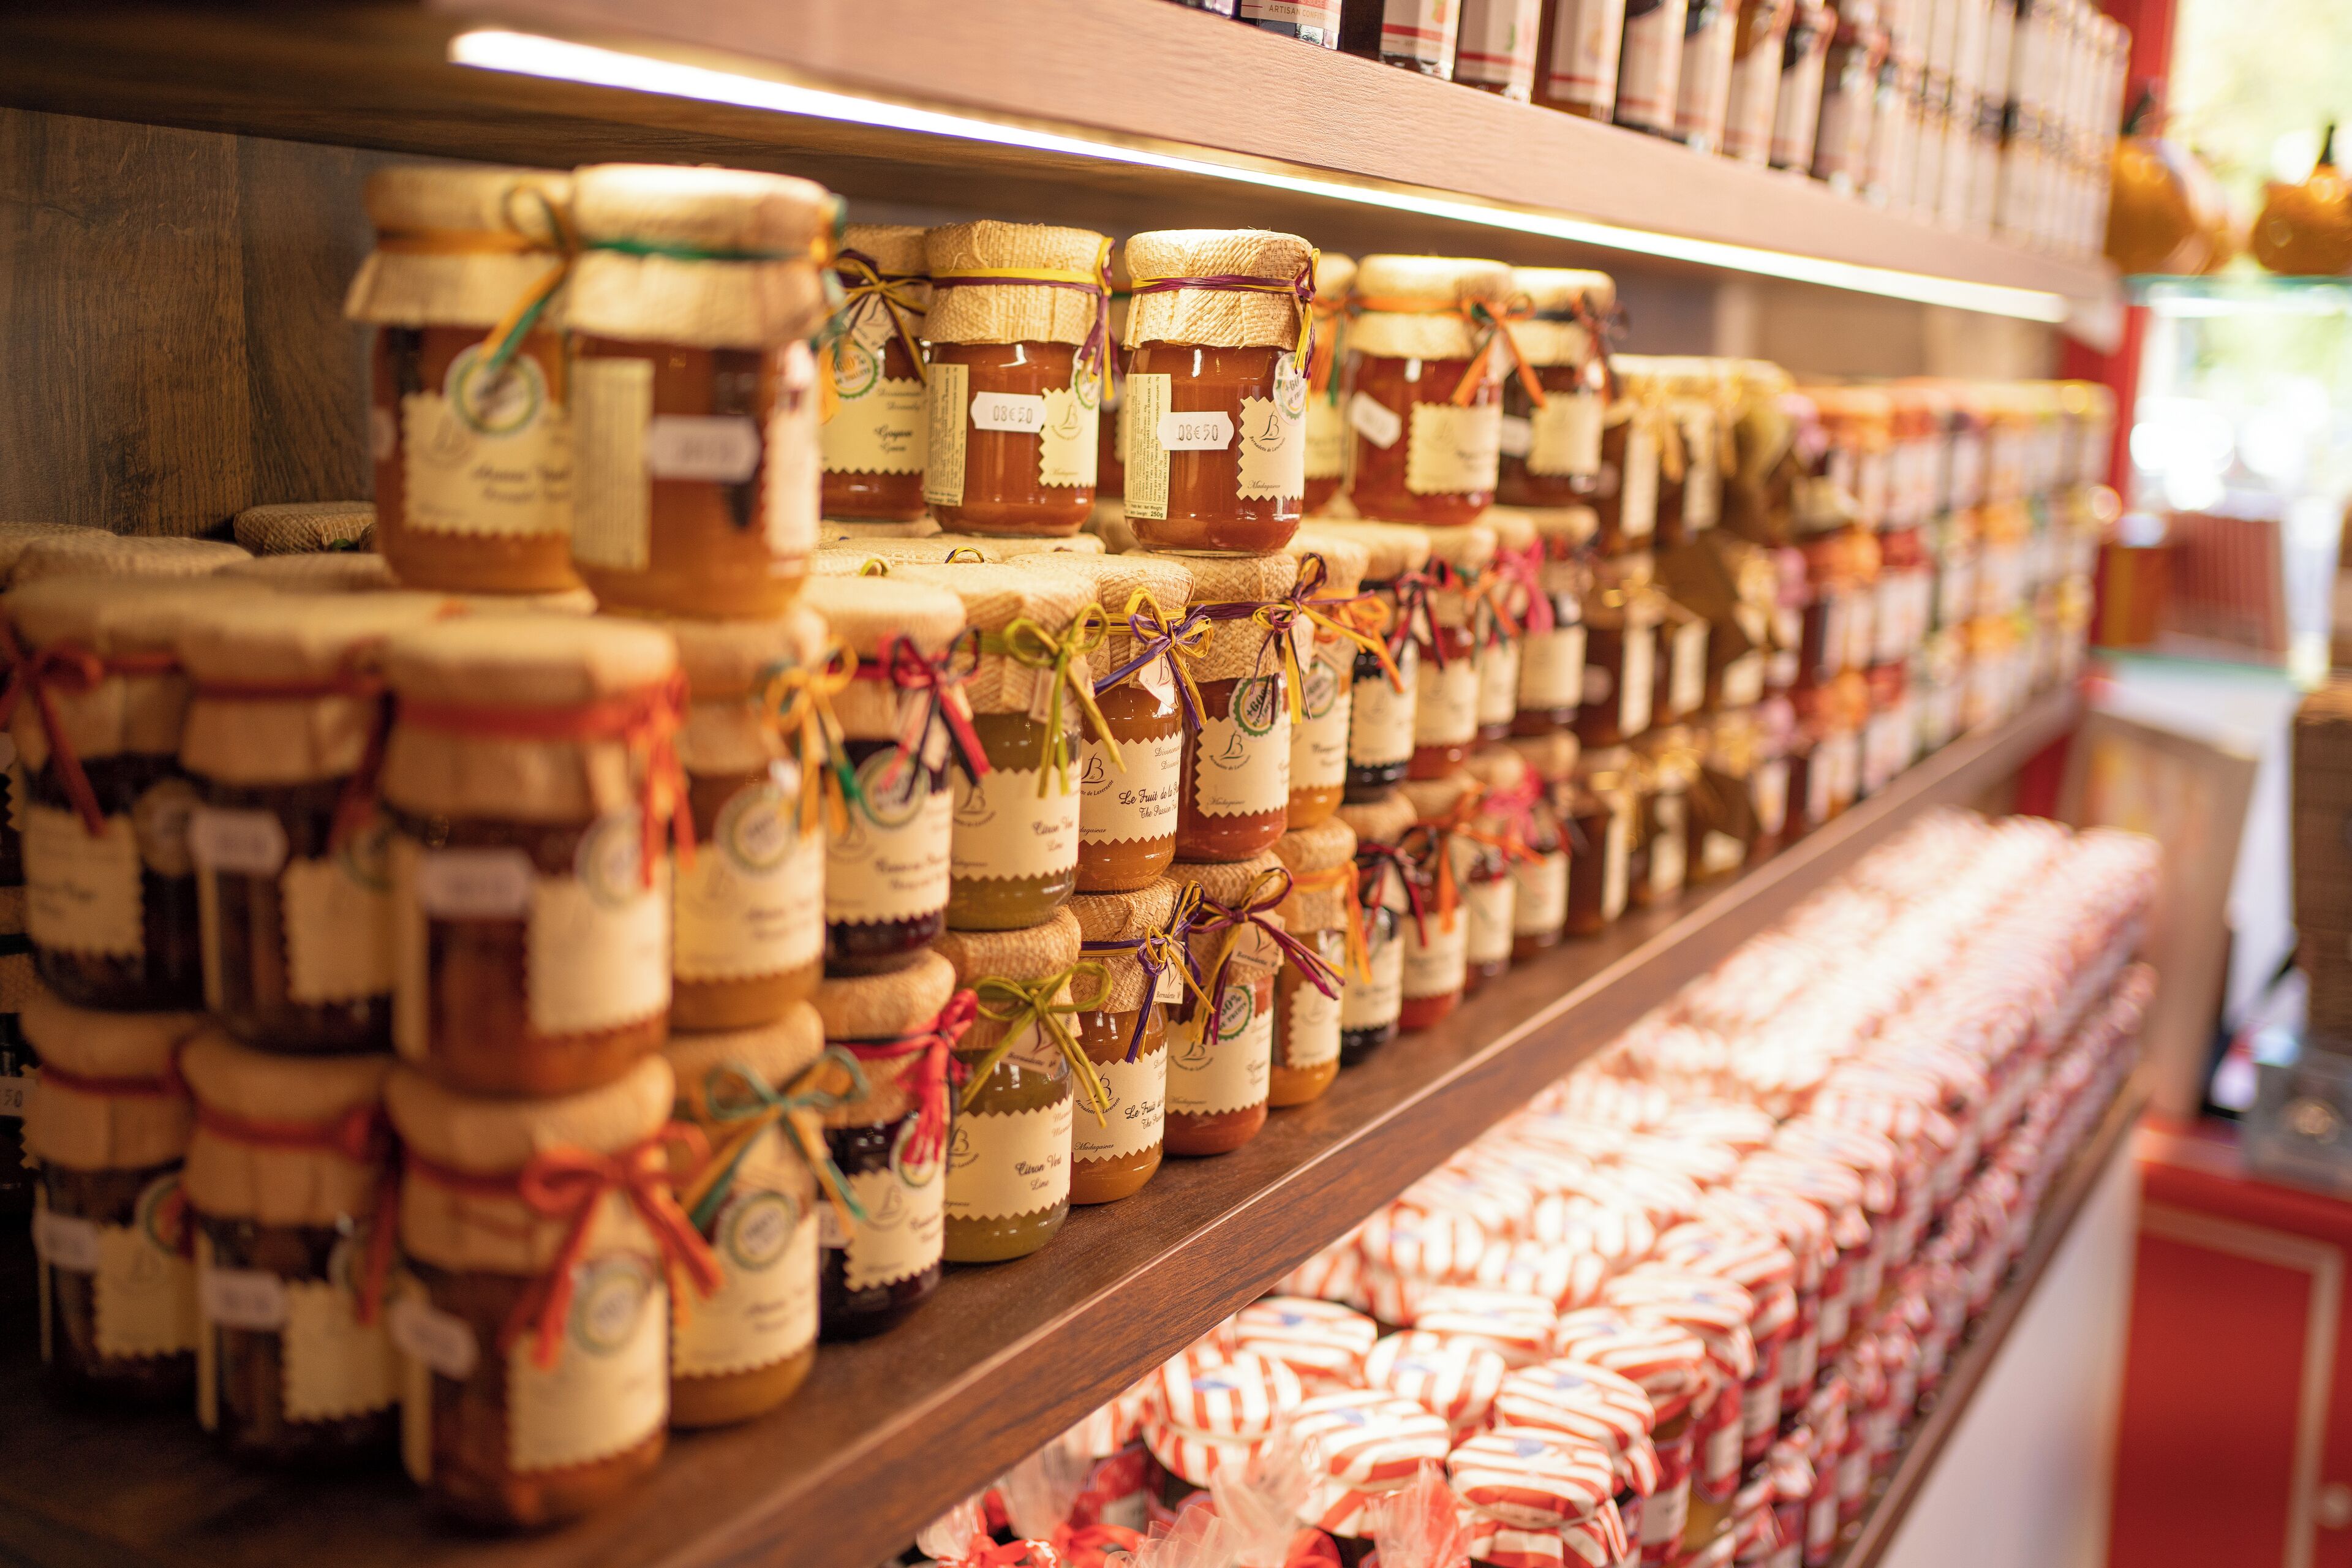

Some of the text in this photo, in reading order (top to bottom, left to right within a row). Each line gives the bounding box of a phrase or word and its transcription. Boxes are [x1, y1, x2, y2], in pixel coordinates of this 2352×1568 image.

[1269, 5, 1327, 20] ARTISAN CONFITU
[993, 405, 1033, 424] 08€50
[1178, 424, 1218, 441] 08€50
[1093, 779, 1114, 796] Lavernette
[1118, 790, 1137, 805] Le
[1139, 788, 1158, 803] Fruit
[1160, 786, 1167, 799] de
[1168, 784, 1172, 797] la
[1139, 807, 1153, 818] The
[1154, 805, 1170, 816] Passion
[1227, 1001, 1246, 1022] FRUITS
[1076, 1097, 1120, 1115] Bernadette Lavernette
[1125, 1104, 1140, 1119] Le
[1142, 1117, 1152, 1129] The
[1074, 1142, 1114, 1153] Madagascar
[1015, 1153, 1062, 1177] Citron Vert
[1031, 1178, 1050, 1191] Lime
